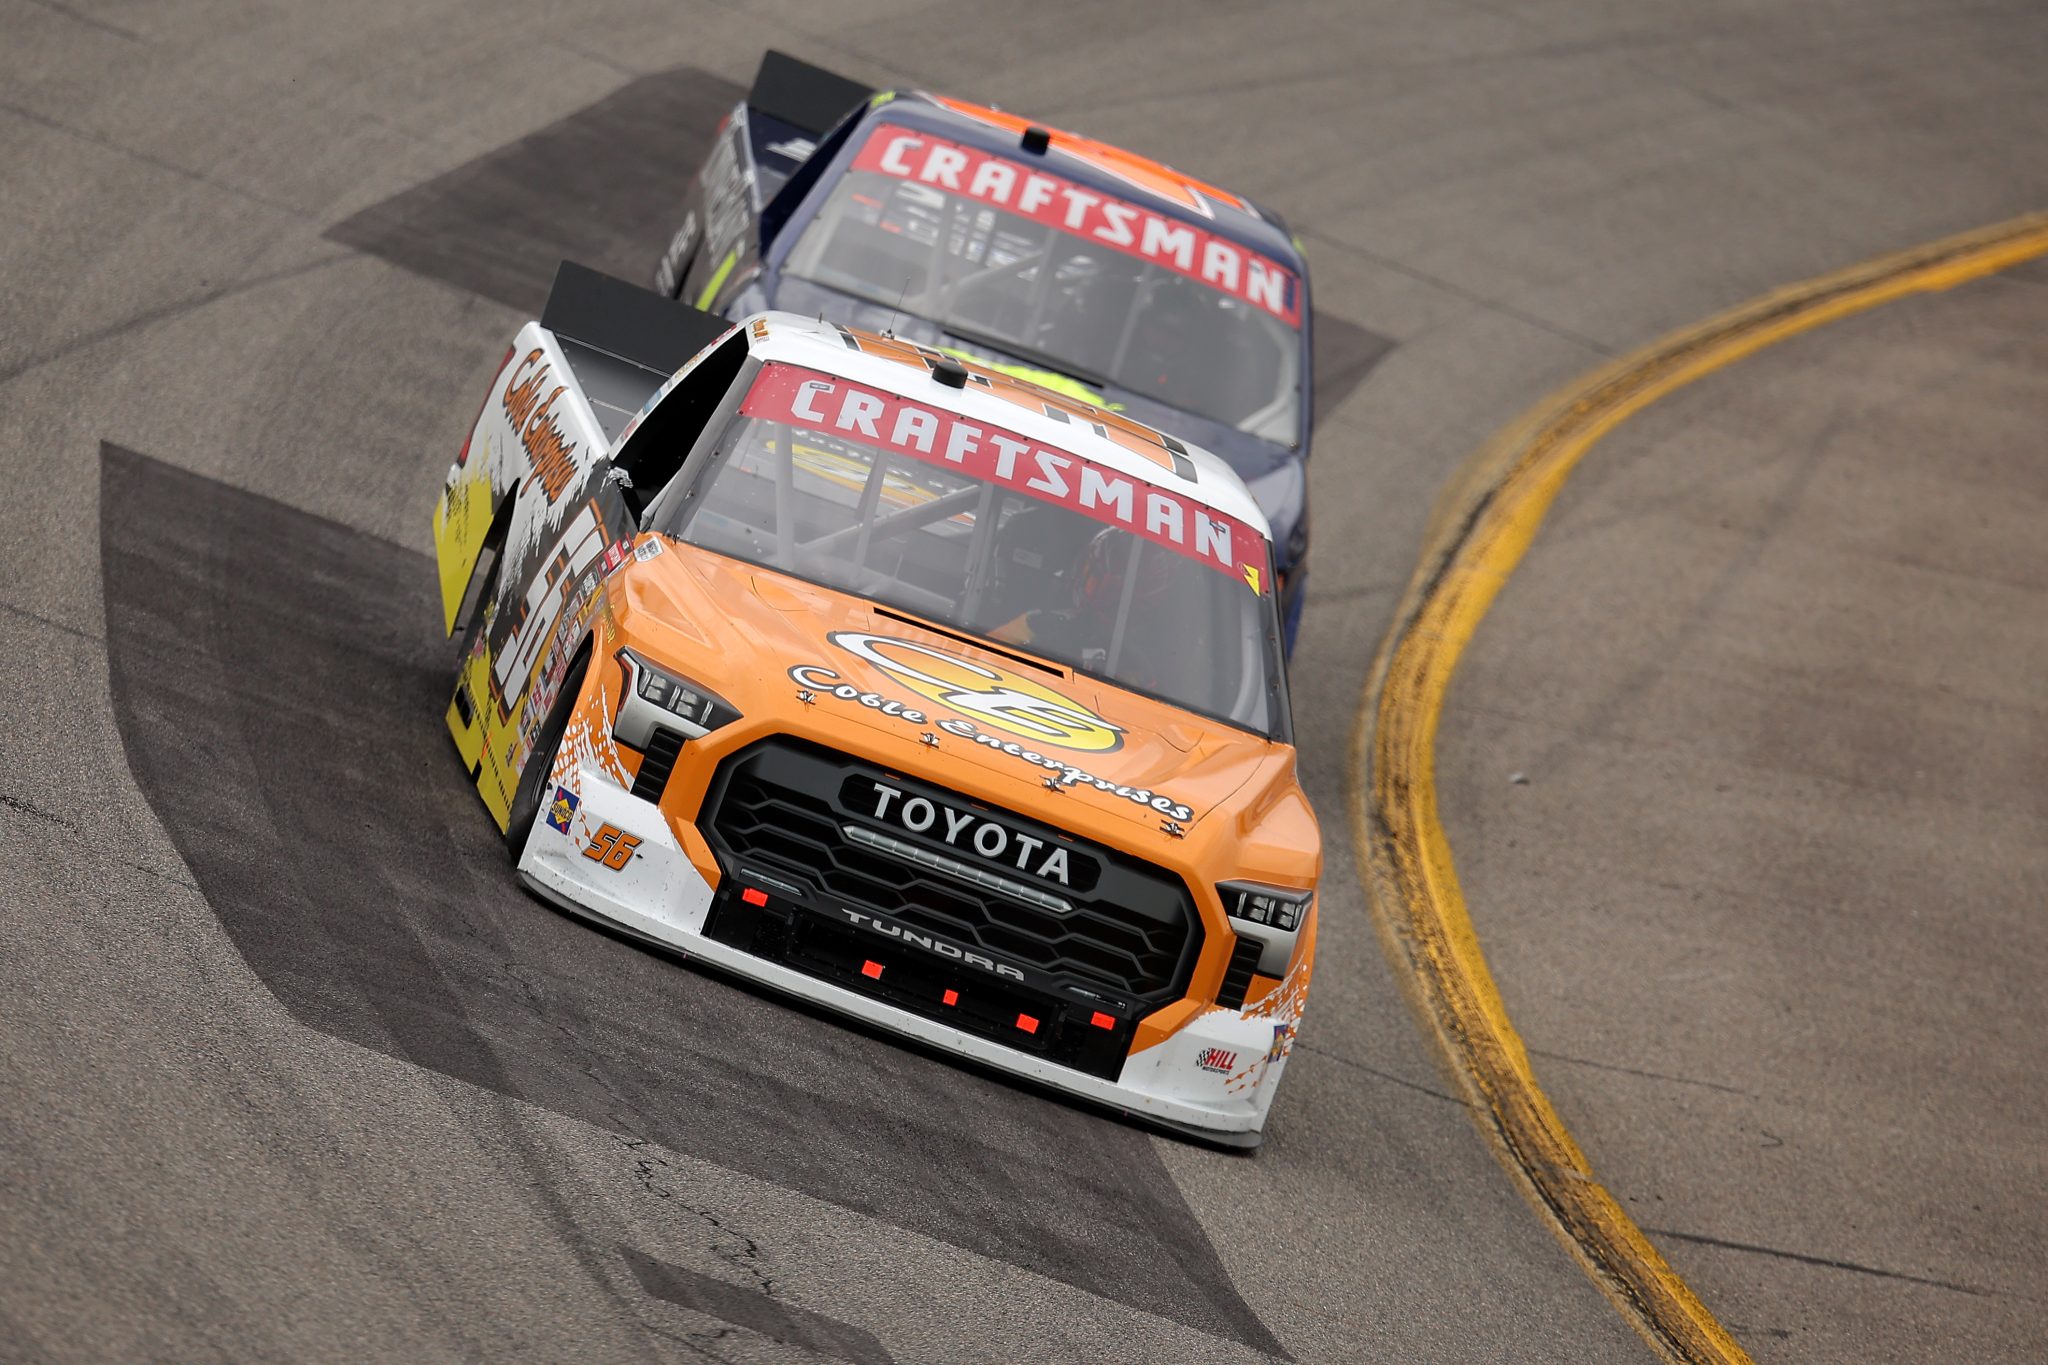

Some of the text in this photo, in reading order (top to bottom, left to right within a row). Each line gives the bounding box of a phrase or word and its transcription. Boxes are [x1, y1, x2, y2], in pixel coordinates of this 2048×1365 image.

[879, 134, 1288, 314] CRAFTSMAN
[791, 380, 1233, 568] CRAFTSMAN
[491, 495, 606, 725] 56
[787, 664, 1195, 823] Coble Enterprises
[583, 821, 644, 872] 56
[872, 782, 1071, 886] TOYOTA
[842, 908, 1025, 981] TUNDRA
[1205, 1047, 1237, 1070] HILL
